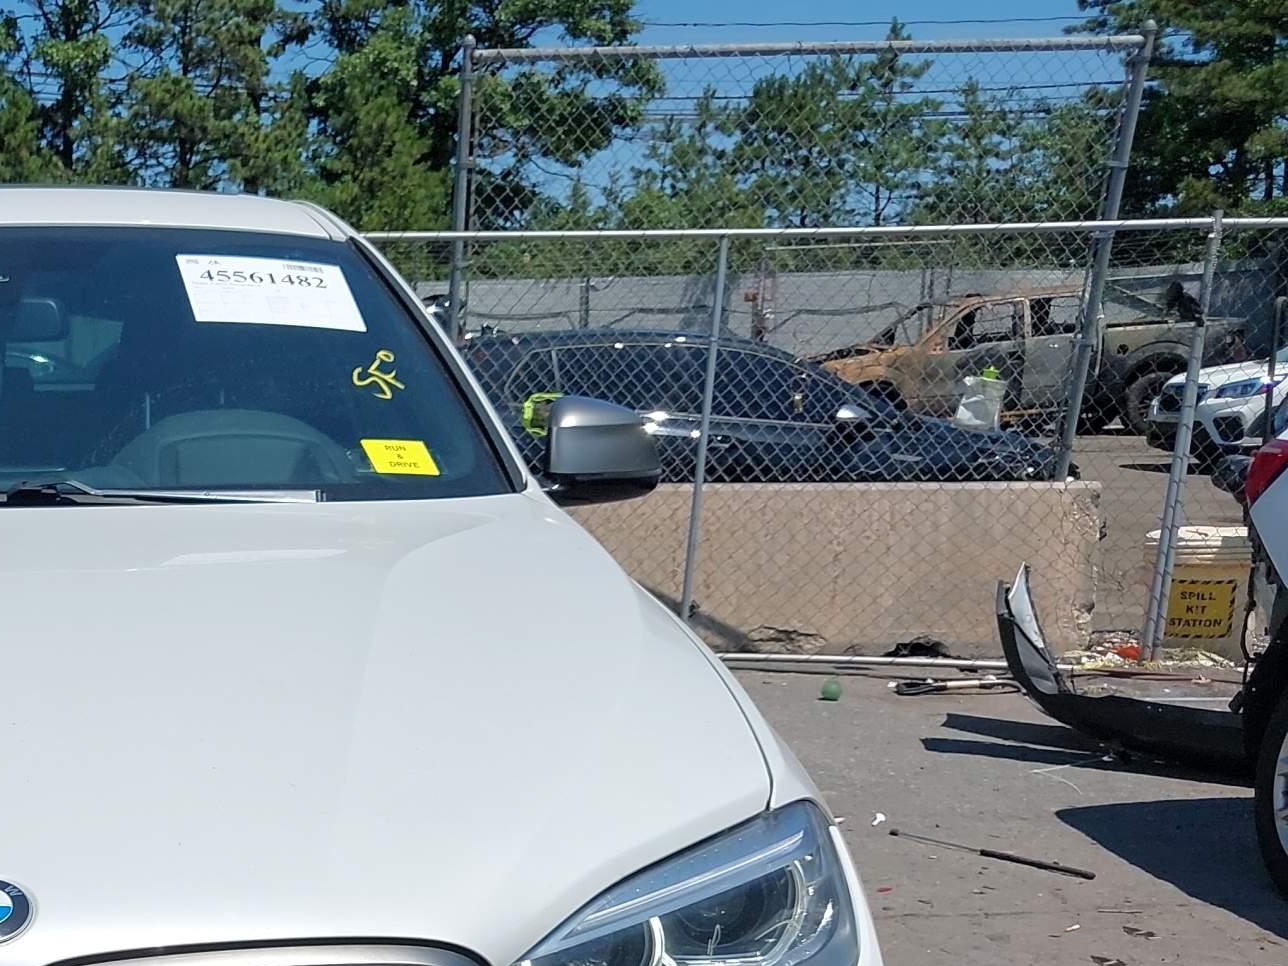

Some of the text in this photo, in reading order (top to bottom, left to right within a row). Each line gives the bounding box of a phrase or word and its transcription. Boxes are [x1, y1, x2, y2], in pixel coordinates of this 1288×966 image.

[200, 269, 328, 290] 45561482
[384, 444, 407, 452] RUN
[389, 461, 421, 469] DRIVE
[1180, 591, 1216, 601] SPILL
[1185, 605, 1207, 614] KIT
[1169, 617, 1222, 627] STATION
